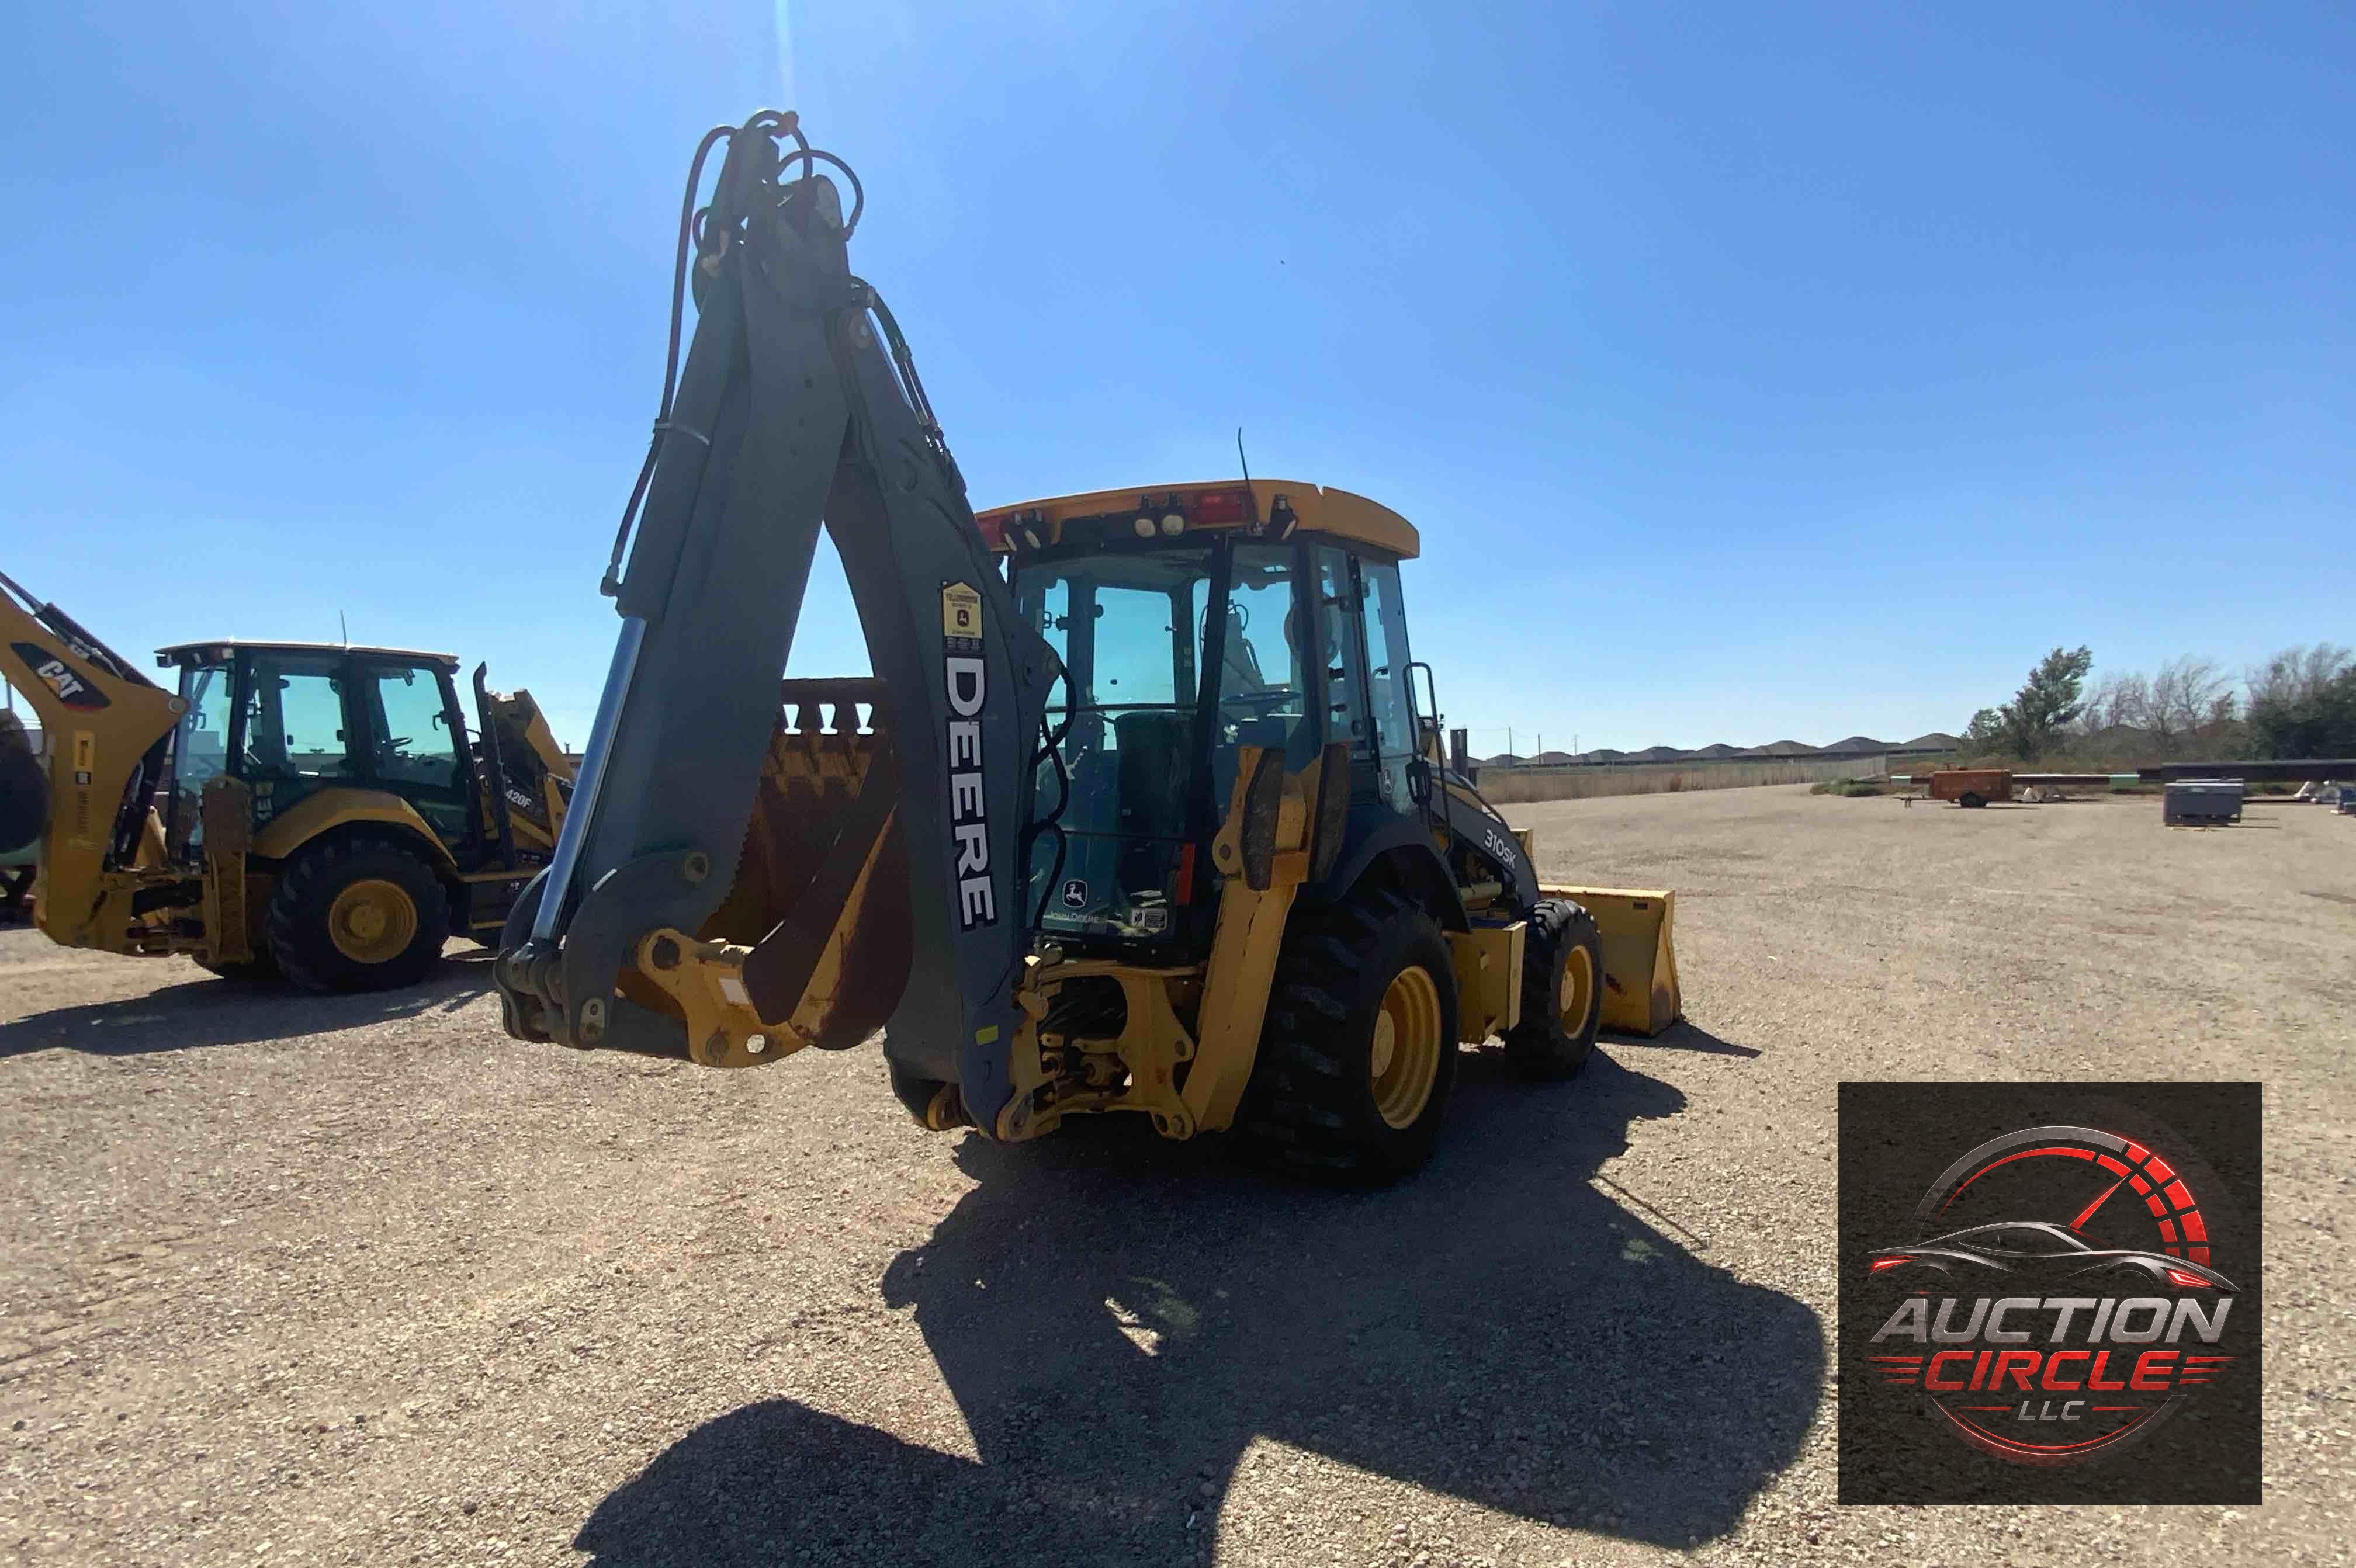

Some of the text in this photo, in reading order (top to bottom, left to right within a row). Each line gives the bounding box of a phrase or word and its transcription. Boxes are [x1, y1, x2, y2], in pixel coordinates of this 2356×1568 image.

[37, 661, 84, 698] CAT
[506, 789, 532, 807] 420F
[947, 658, 993, 925] DEERE
[1485, 829, 1516, 869] 310SK
